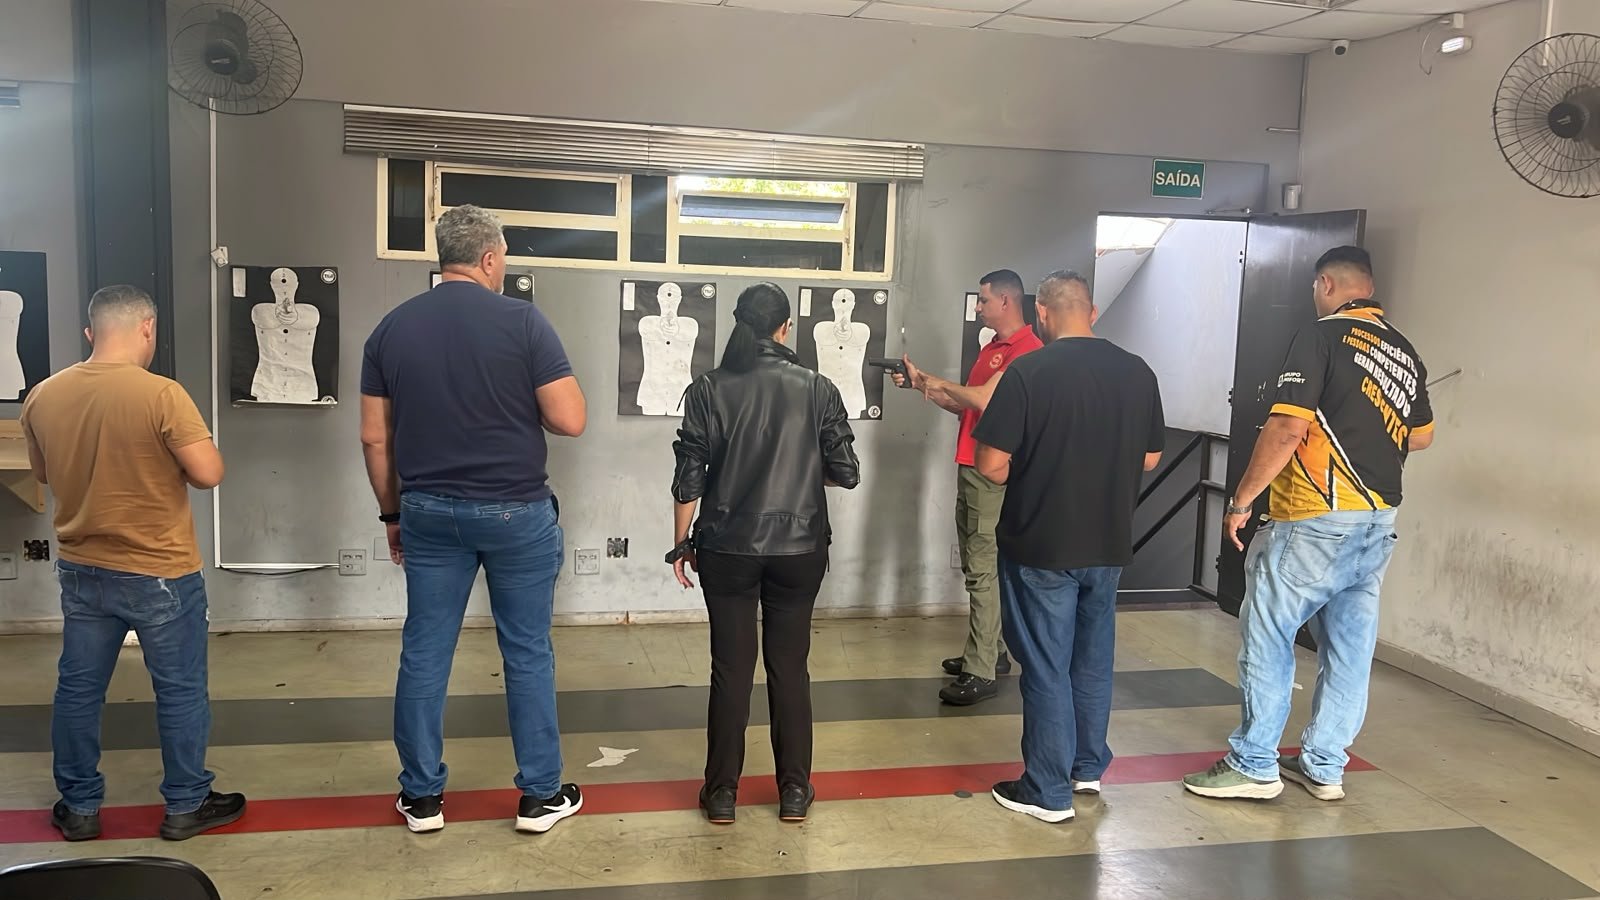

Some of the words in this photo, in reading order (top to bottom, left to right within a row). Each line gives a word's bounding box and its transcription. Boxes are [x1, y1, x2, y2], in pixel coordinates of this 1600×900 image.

[1155, 169, 1201, 188] SAÍDA
[1342, 335, 1348, 343] E
[1346, 336, 1370, 354] PESSOAS
[1351, 327, 1381, 348] PROCESSOS
[1353, 352, 1375, 374] GERAM
